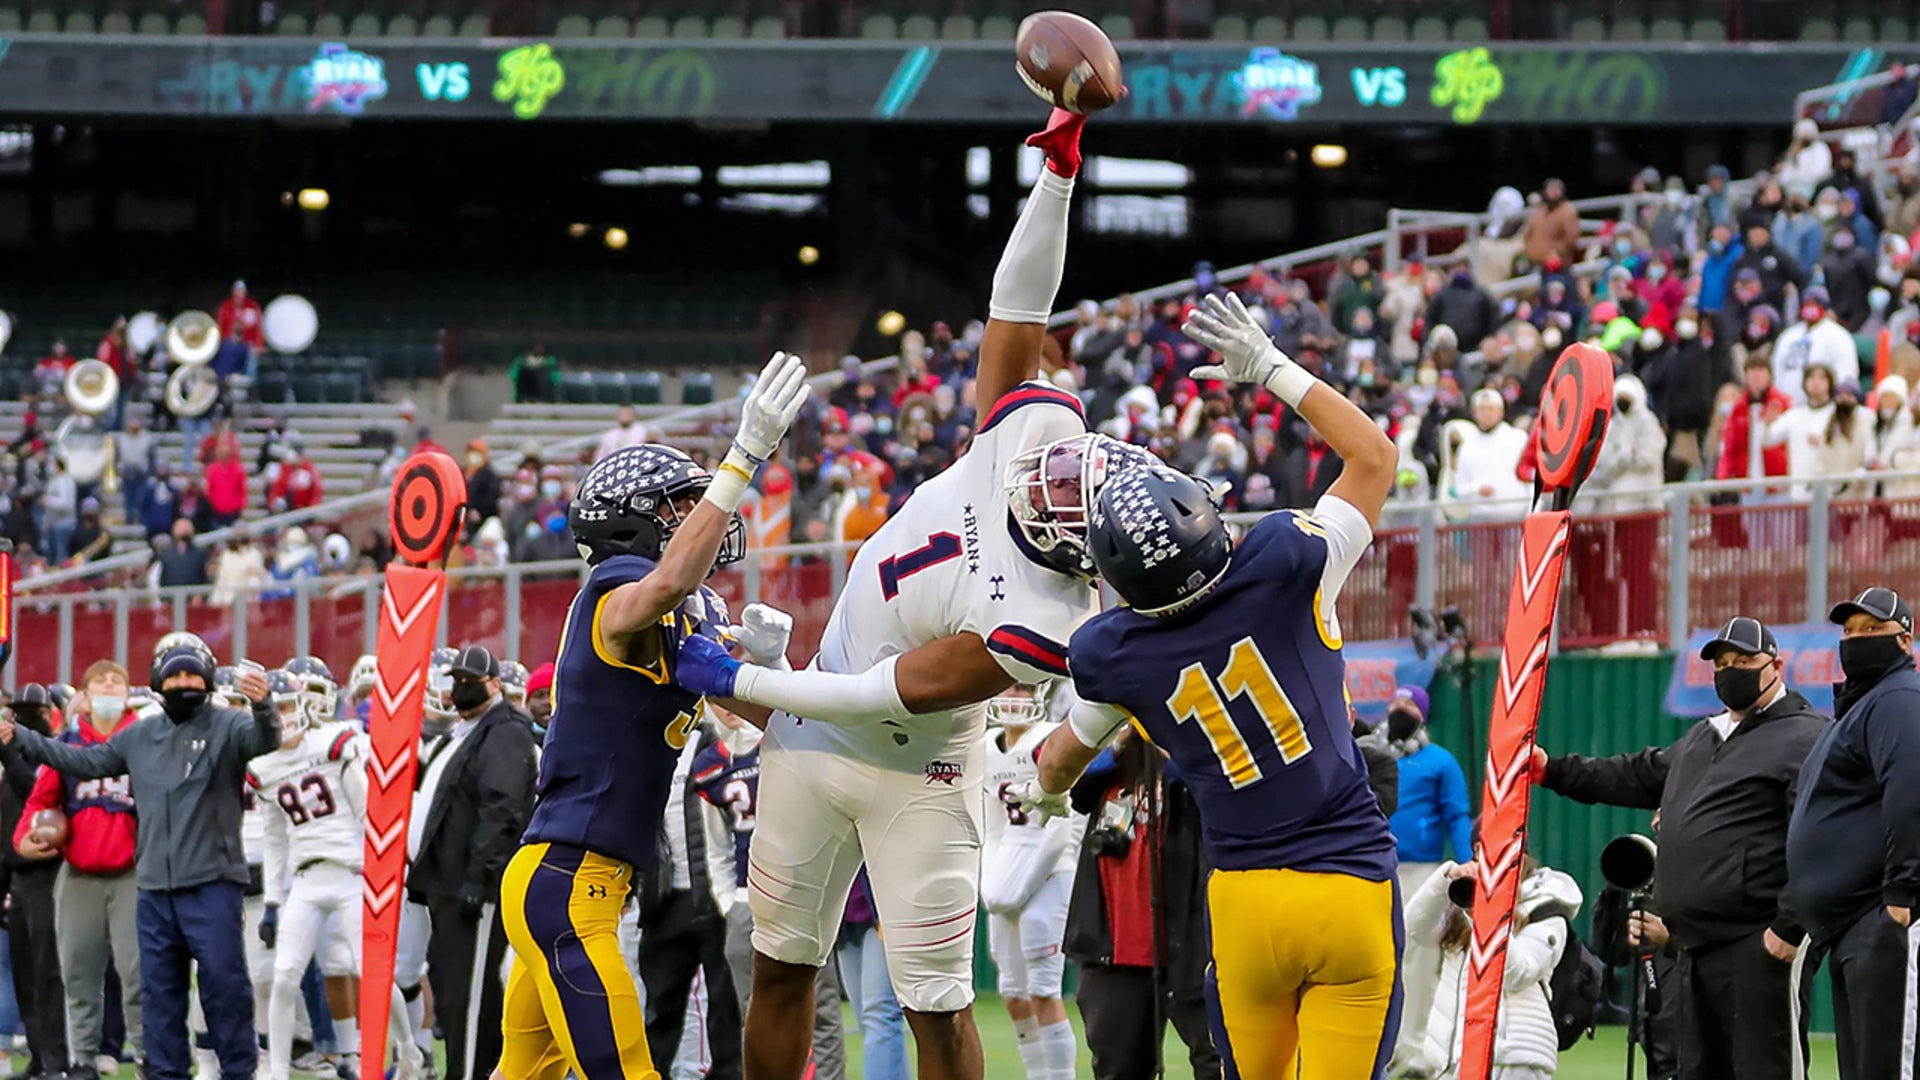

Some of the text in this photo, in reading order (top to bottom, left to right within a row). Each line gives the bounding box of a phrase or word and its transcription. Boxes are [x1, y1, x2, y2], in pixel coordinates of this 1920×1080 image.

[416, 61, 470, 101] VS
[1351, 66, 1406, 106] VS
[878, 530, 963, 602] 1
[1166, 635, 1313, 790] 11
[277, 772, 337, 826] 83
[1645, 960, 1657, 989] SONY
